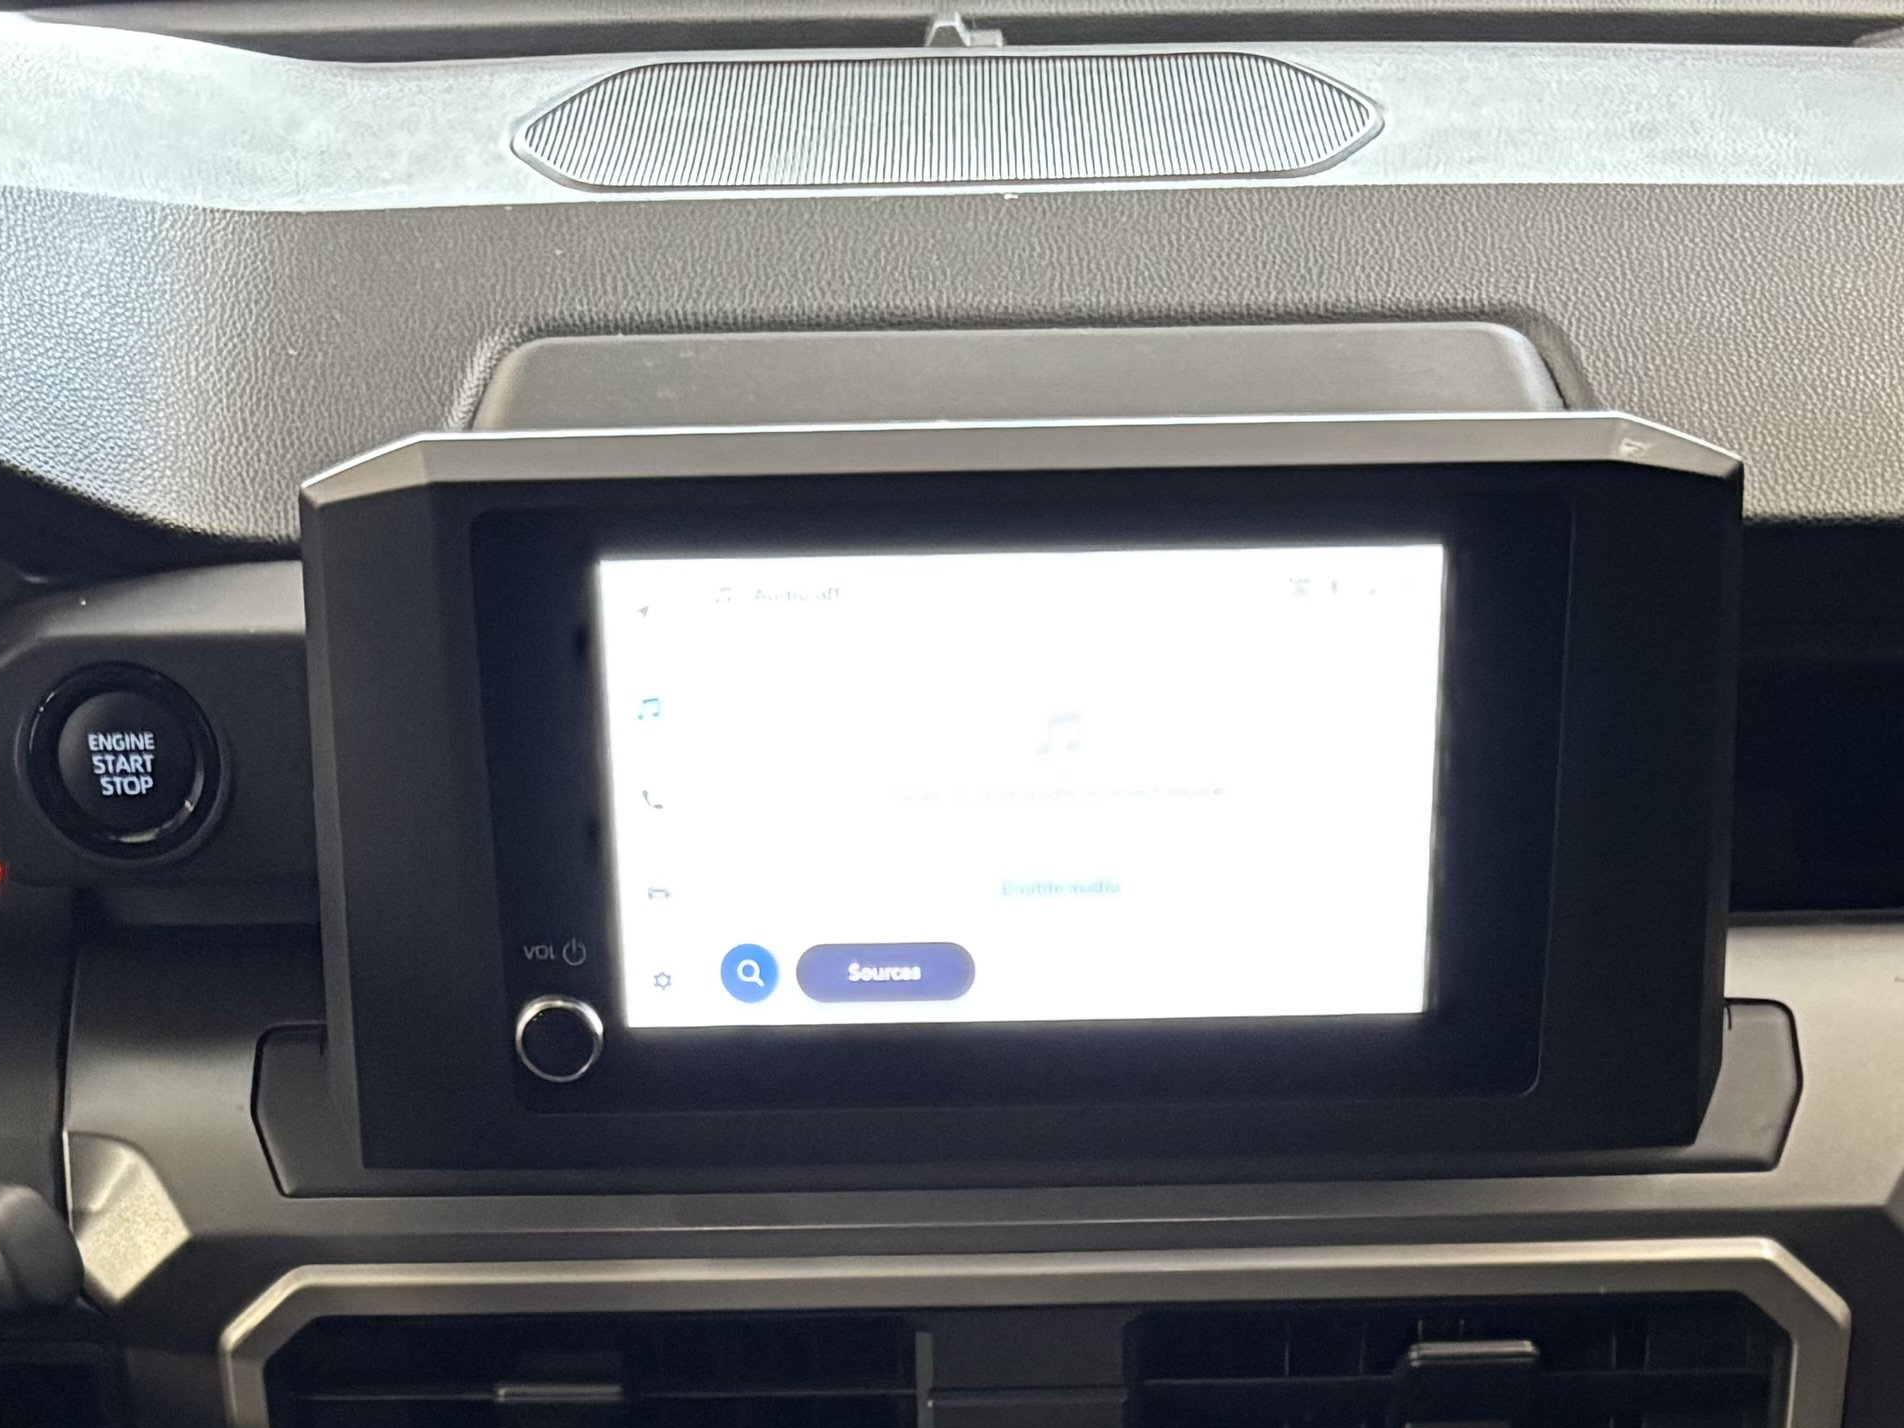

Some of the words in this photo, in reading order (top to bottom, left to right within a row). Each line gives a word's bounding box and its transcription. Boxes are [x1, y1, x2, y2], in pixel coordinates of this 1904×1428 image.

[87, 731, 156, 751] ENGINE
[91, 753, 155, 775] START
[99, 774, 154, 796] STOP
[523, 944, 555, 960] VOL
[847, 962, 922, 982] Sources
